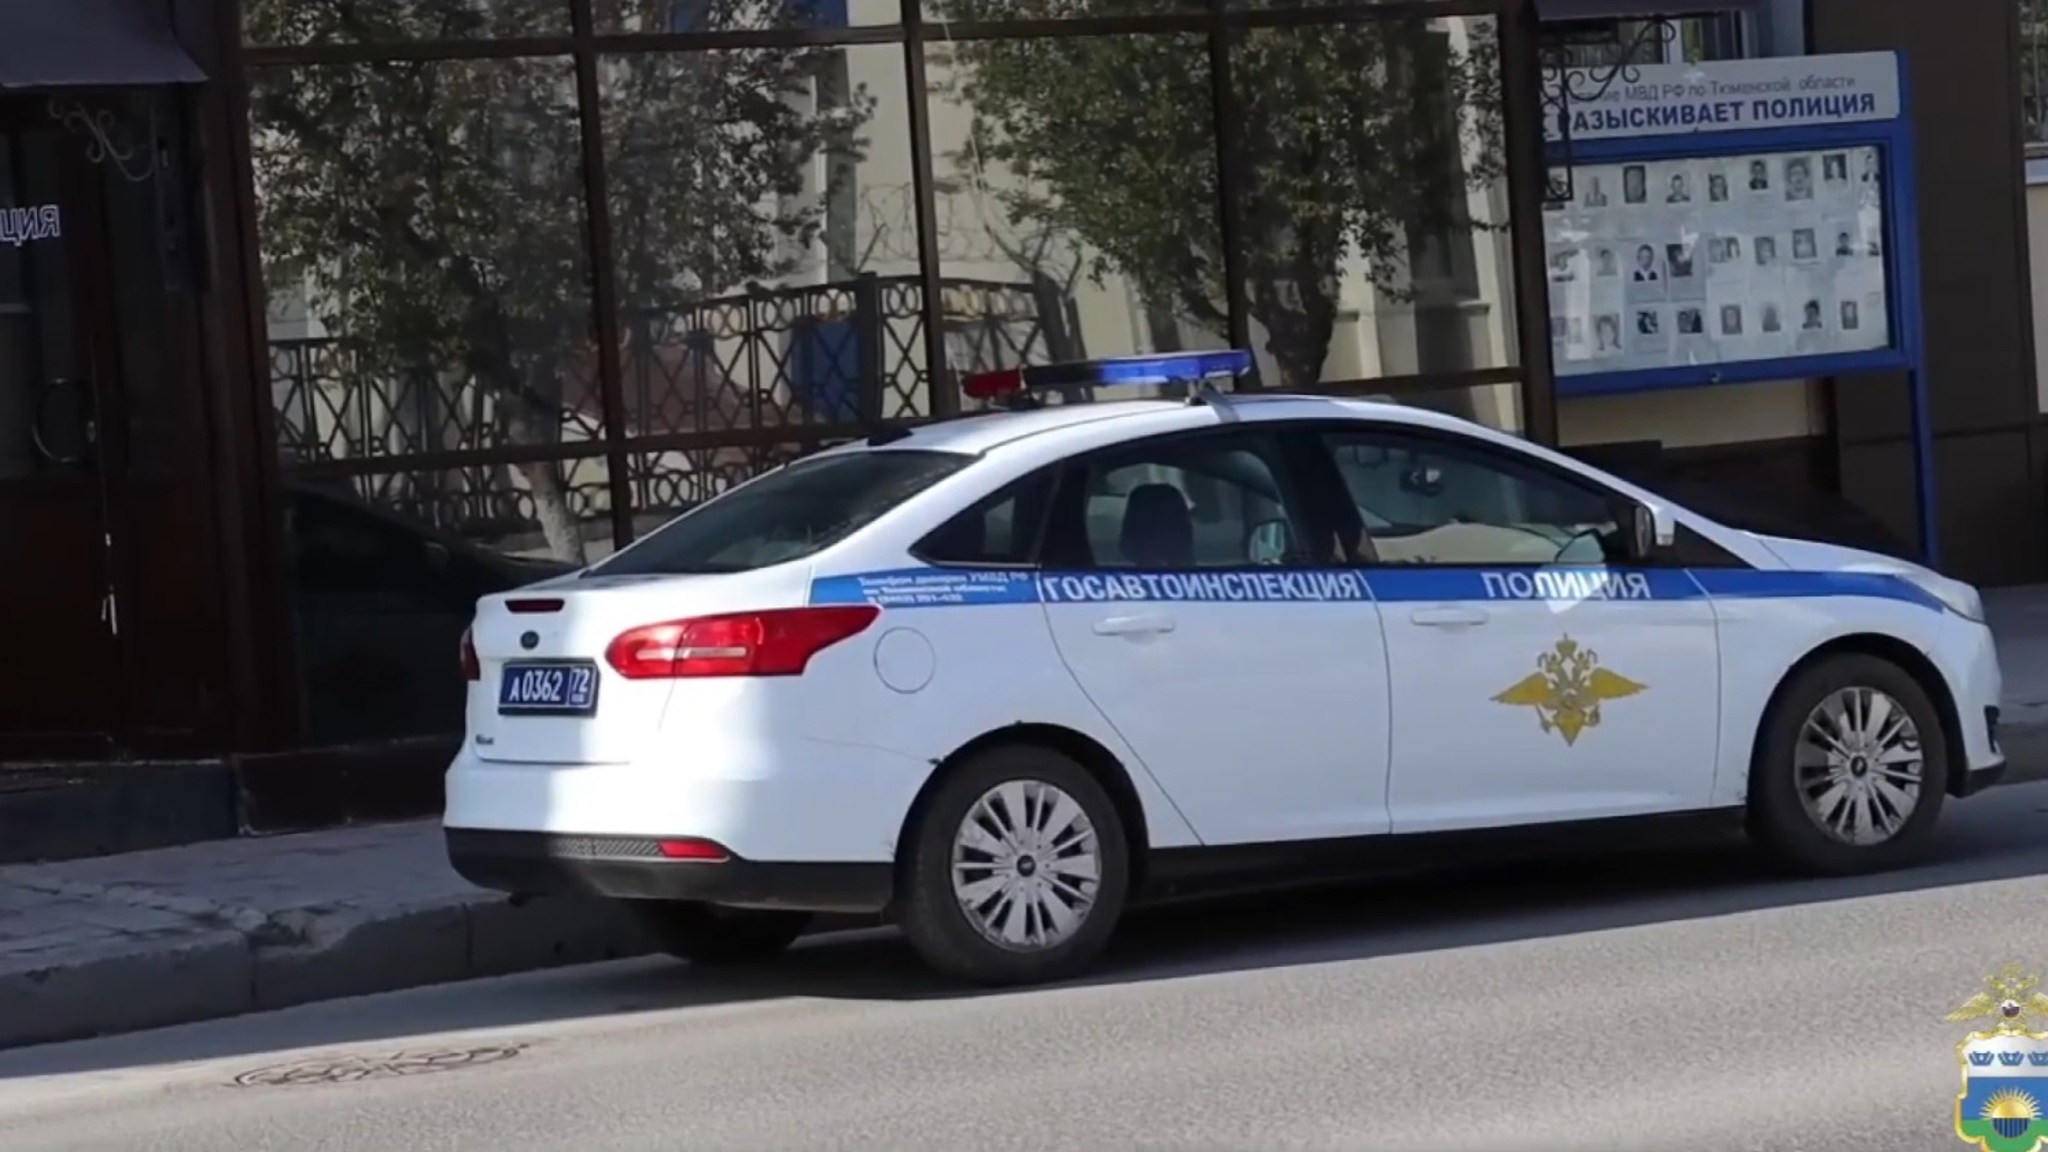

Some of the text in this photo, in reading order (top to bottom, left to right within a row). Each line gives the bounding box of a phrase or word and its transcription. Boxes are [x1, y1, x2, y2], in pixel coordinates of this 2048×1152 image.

[1624, 85, 1659, 101] МВД
[1662, 83, 1686, 98] РФ
[1688, 86, 1707, 98] по
[1711, 78, 1791, 96] Тюменской
[1798, 74, 1856, 91] области
[1561, 93, 1875, 133] АЗЫСКИВАЕТ ПОЛИЦИЯ
[1046, 573, 1361, 601] ГОСАВТОИНСПЕКЦИЯ
[1481, 572, 1652, 600] ПОЛИЦИЯ
[572, 668, 590, 692] 72
